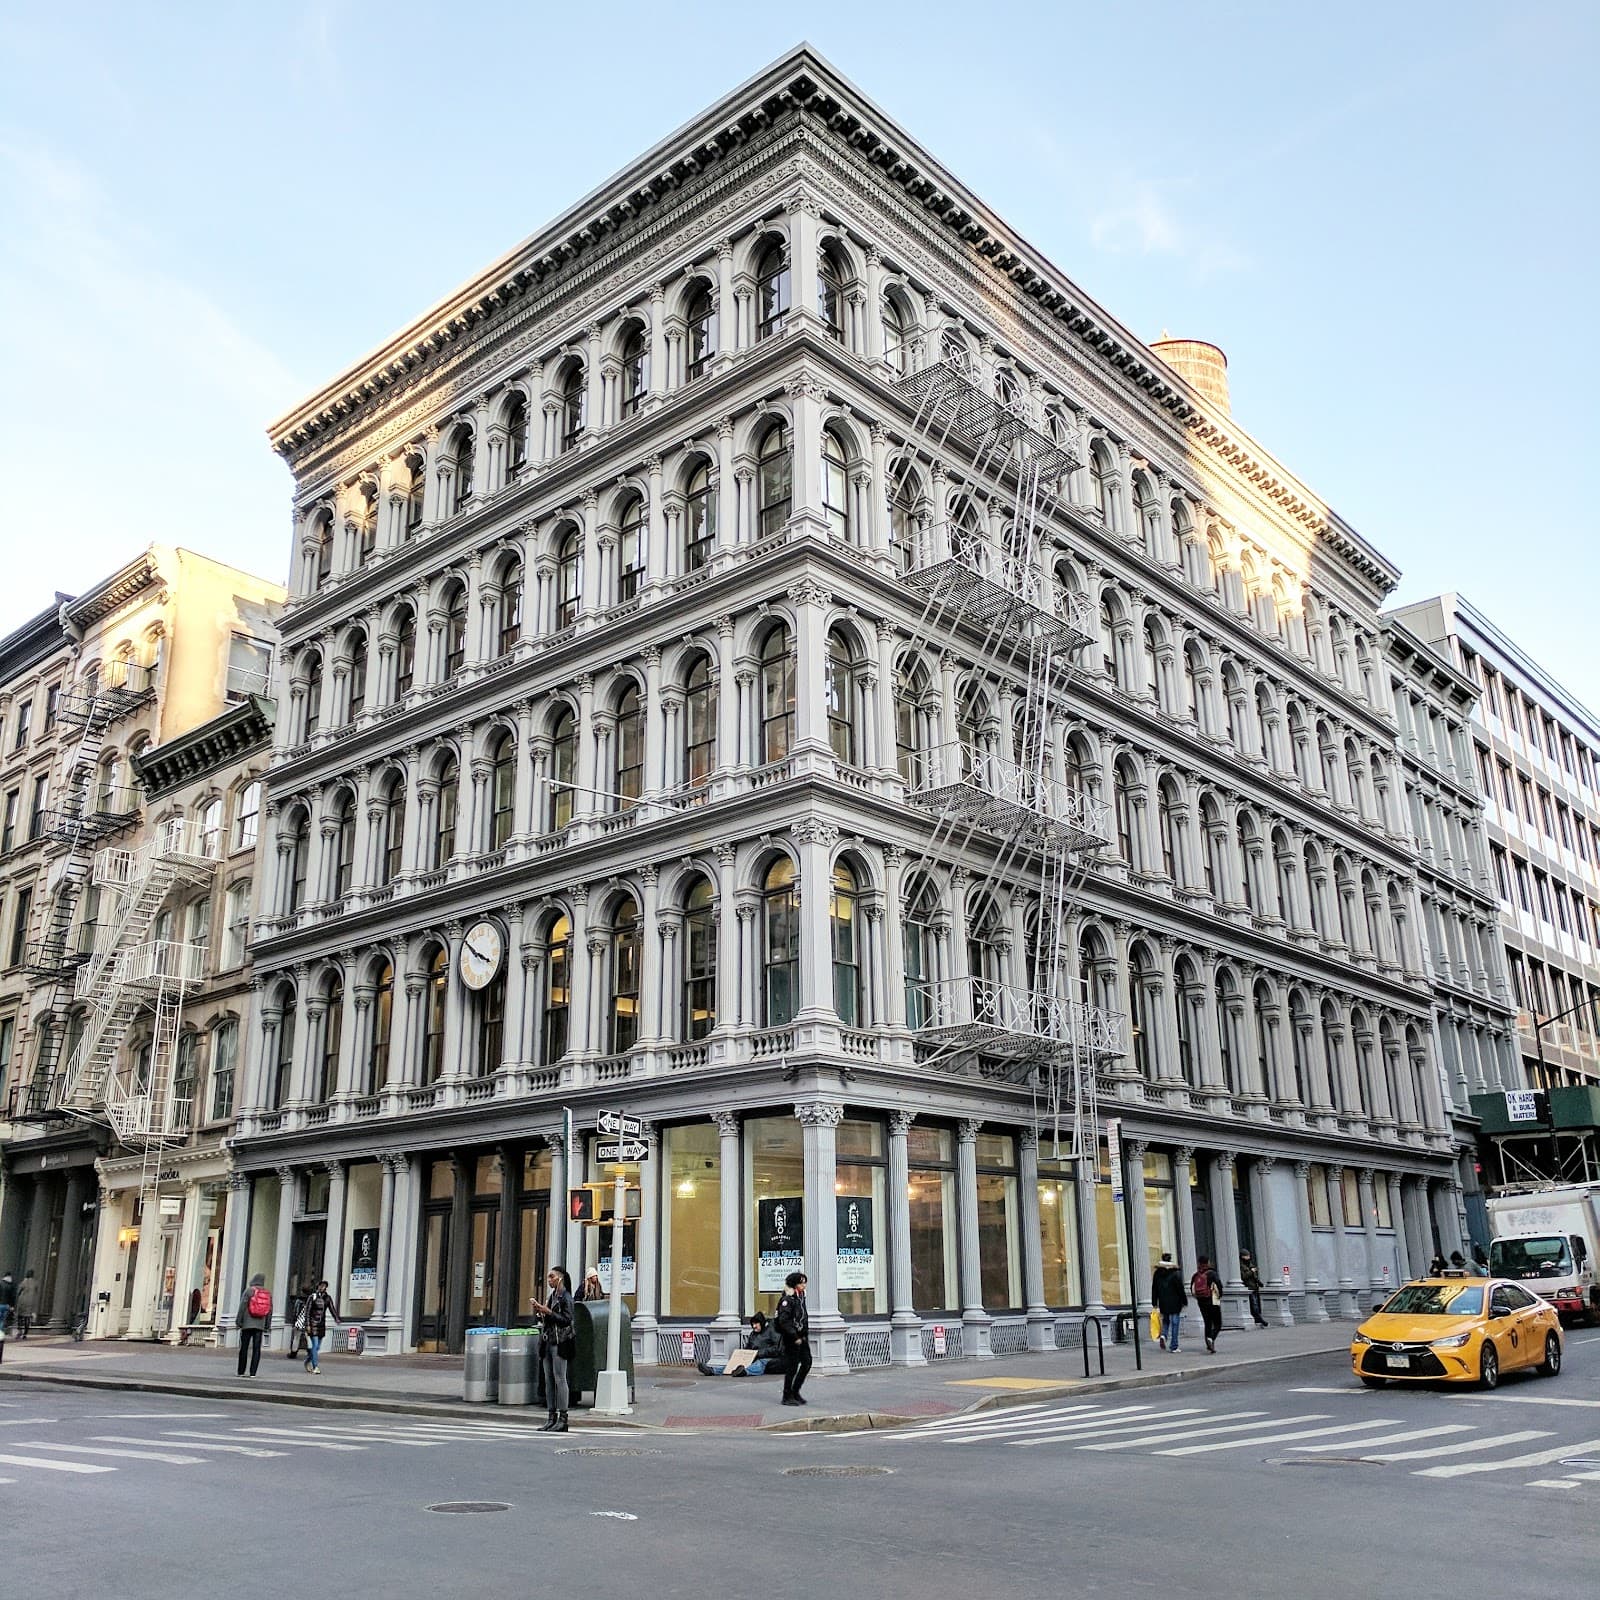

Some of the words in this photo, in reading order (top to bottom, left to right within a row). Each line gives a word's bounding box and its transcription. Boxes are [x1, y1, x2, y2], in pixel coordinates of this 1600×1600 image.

[1508, 1093, 1517, 1104] OK
[1519, 1093, 1533, 1102] HARD
[1513, 1111, 1536, 1119] MATERI
[603, 1118, 617, 1128] ONE
[624, 1122, 638, 1132] WAY
[600, 1148, 617, 1156] ONE
[625, 1145, 643, 1156] WAY
[762, 1250, 780, 1259] RETAIL
[781, 1249, 800, 1258] SPACE
[761, 1258, 772, 1267] 212
[774, 1258, 785, 1266] 841
[786, 1257, 802, 1266] 7732
[837, 1255, 848, 1264] 212
[849, 1255, 859, 1264] 841
